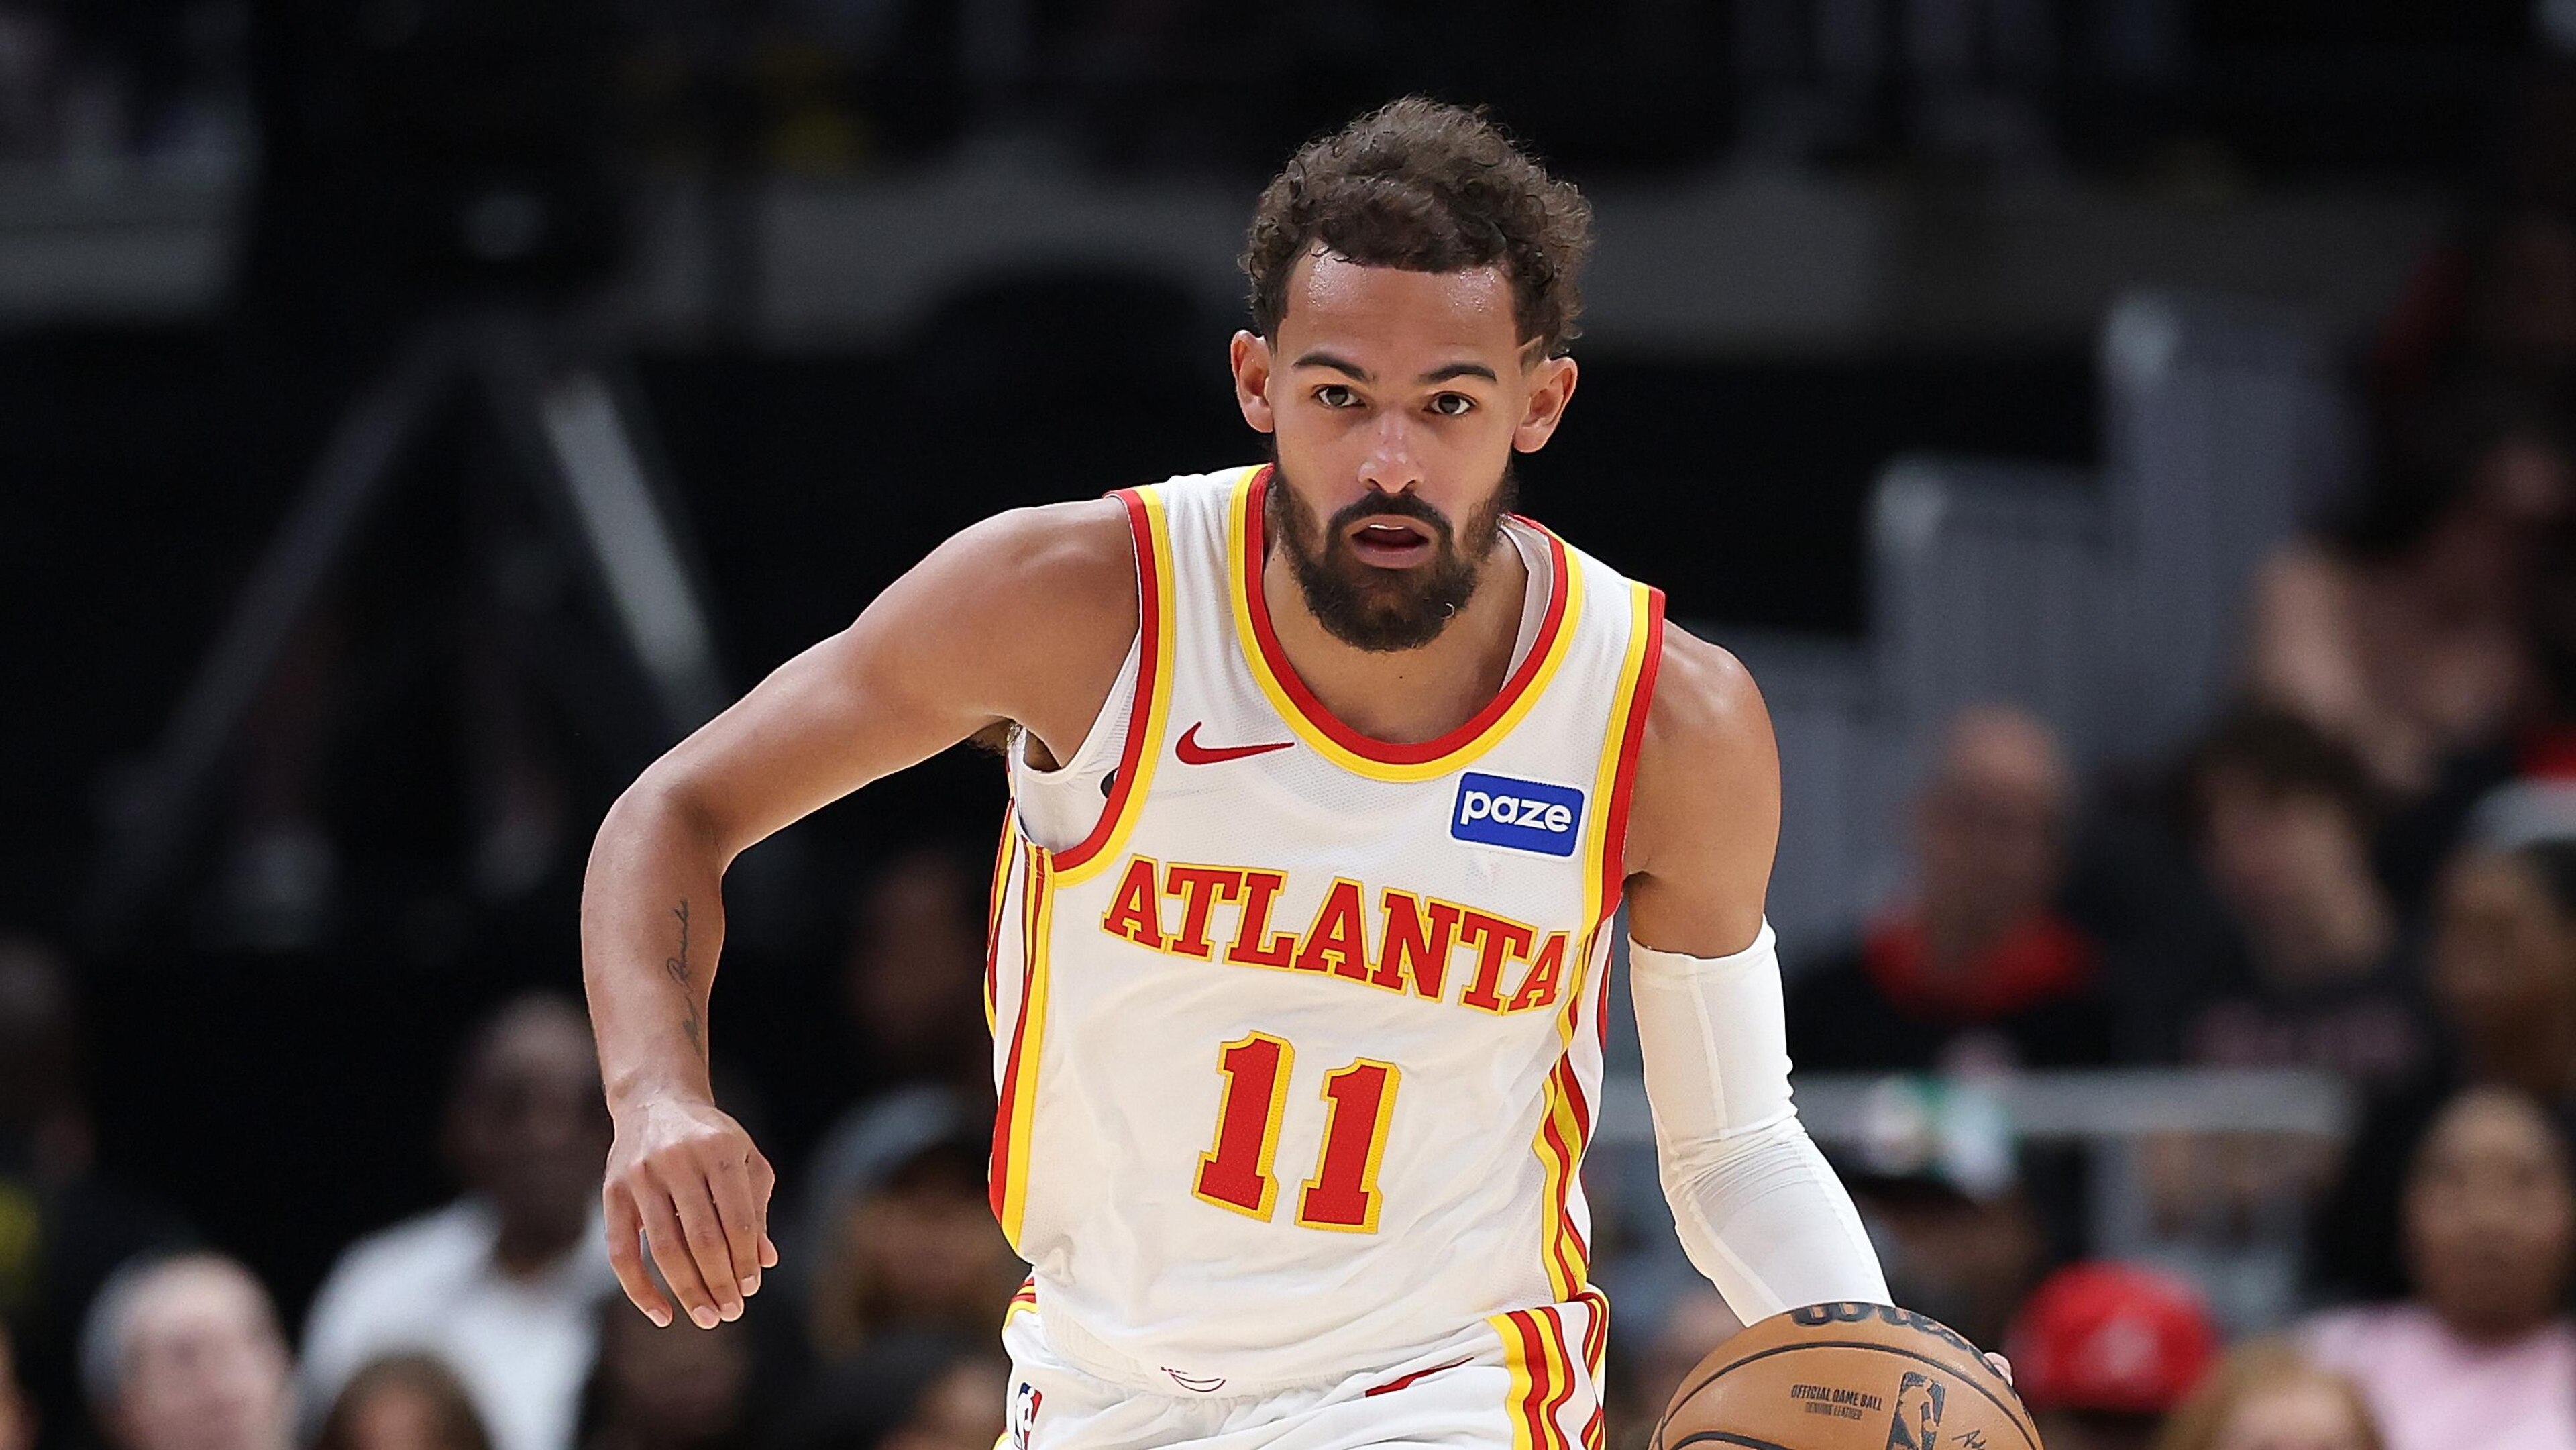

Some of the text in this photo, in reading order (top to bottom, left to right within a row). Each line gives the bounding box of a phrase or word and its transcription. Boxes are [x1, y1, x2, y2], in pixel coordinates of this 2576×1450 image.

[1460, 790, 1572, 833] paze
[1100, 853, 1571, 1017] ATLANTA
[1191, 1029, 1401, 1235] 11
[1790, 1384, 1882, 1411] OFFICIAL GAME BALL
